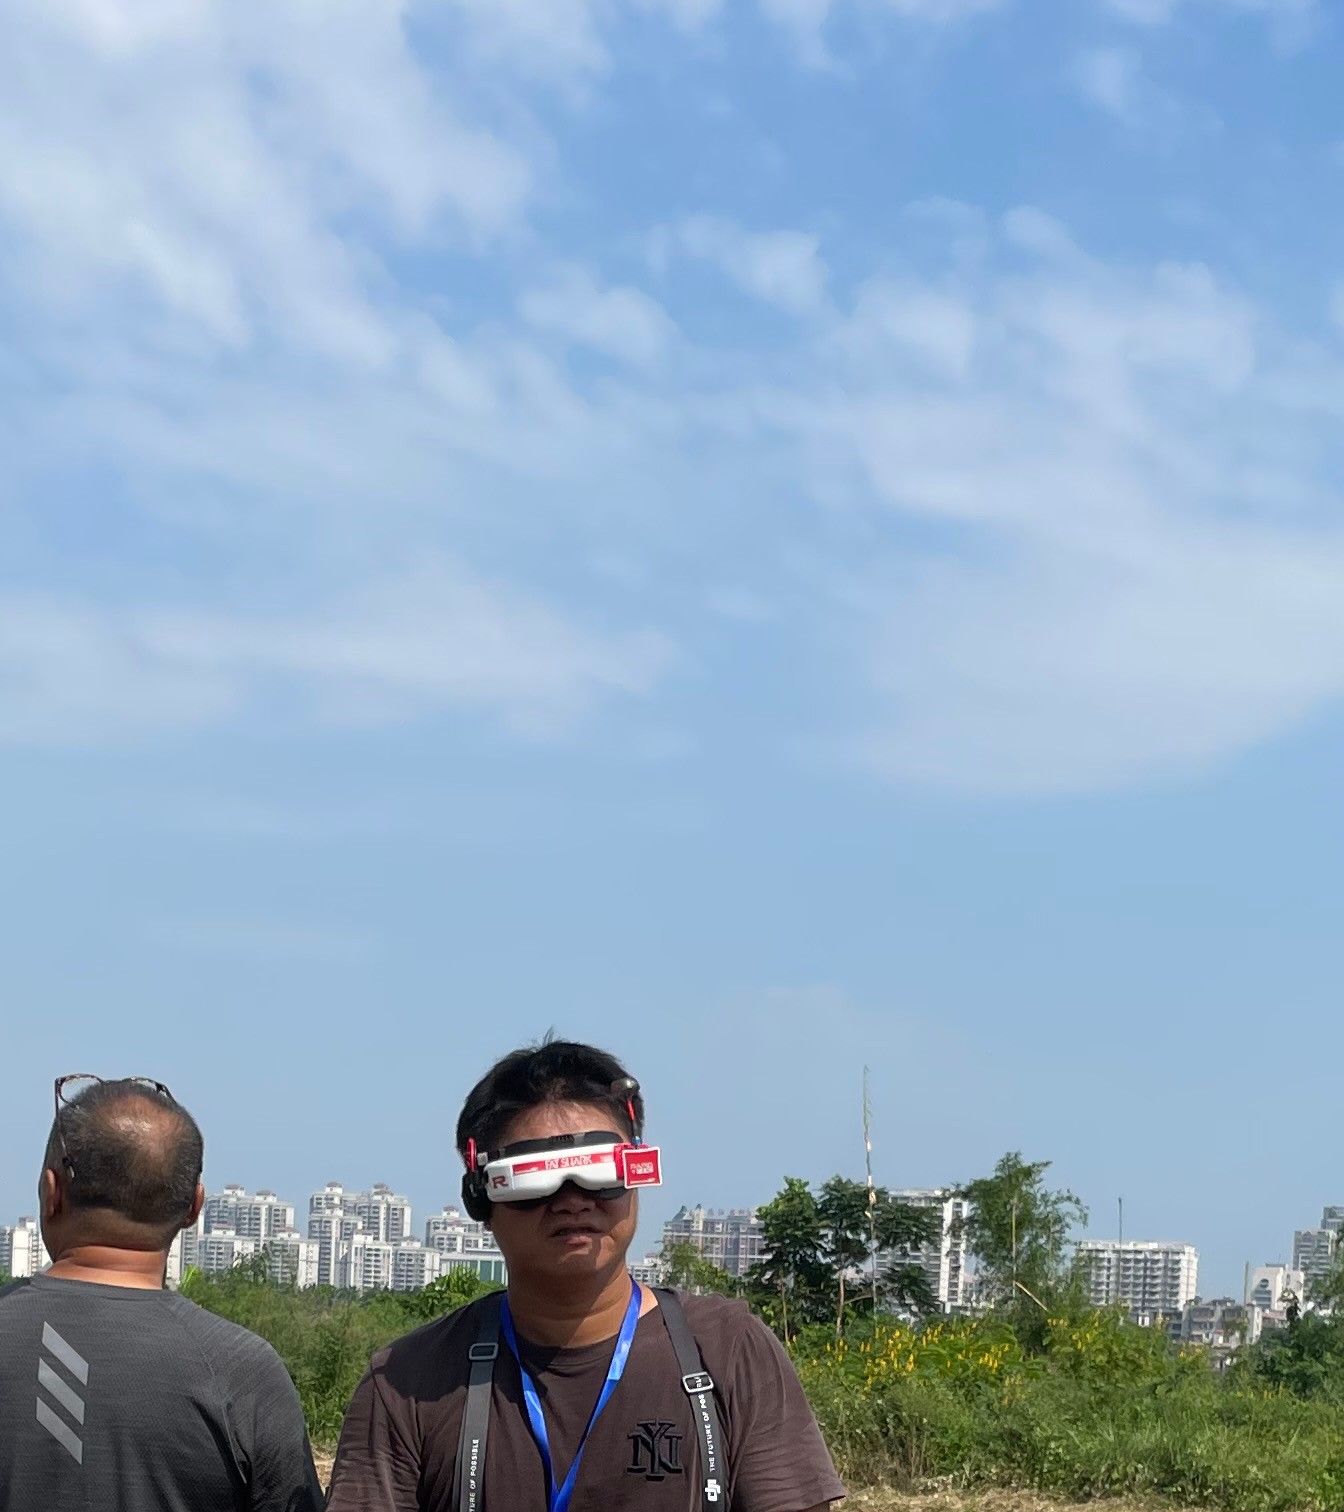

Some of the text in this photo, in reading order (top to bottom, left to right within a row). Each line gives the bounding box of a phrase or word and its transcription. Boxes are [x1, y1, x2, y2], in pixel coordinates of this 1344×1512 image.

[492, 1175, 509, 1189] R
[701, 1411, 710, 1422] OF
[704, 1423, 714, 1455] FUTURE
[470, 1438, 480, 1477] POSSIBLE
[707, 1457, 716, 1473] THE
[469, 1479, 477, 1490] OF
